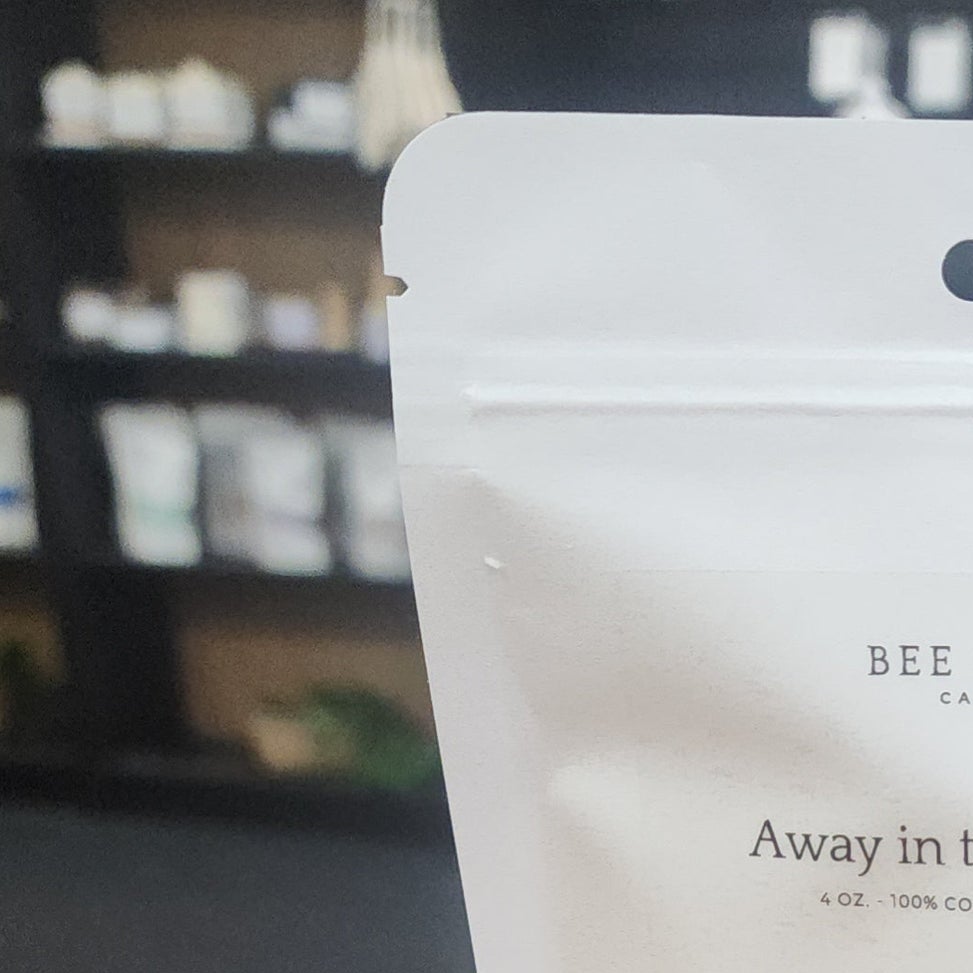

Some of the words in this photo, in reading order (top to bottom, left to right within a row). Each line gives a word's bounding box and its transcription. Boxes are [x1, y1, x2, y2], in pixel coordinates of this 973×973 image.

[866, 644, 953, 677] BEE
[748, 818, 884, 878] Away
[897, 824, 946, 866] in
[819, 891, 832, 907] 4
[837, 891, 870, 908] OZ.
[889, 893, 939, 911] 100%
